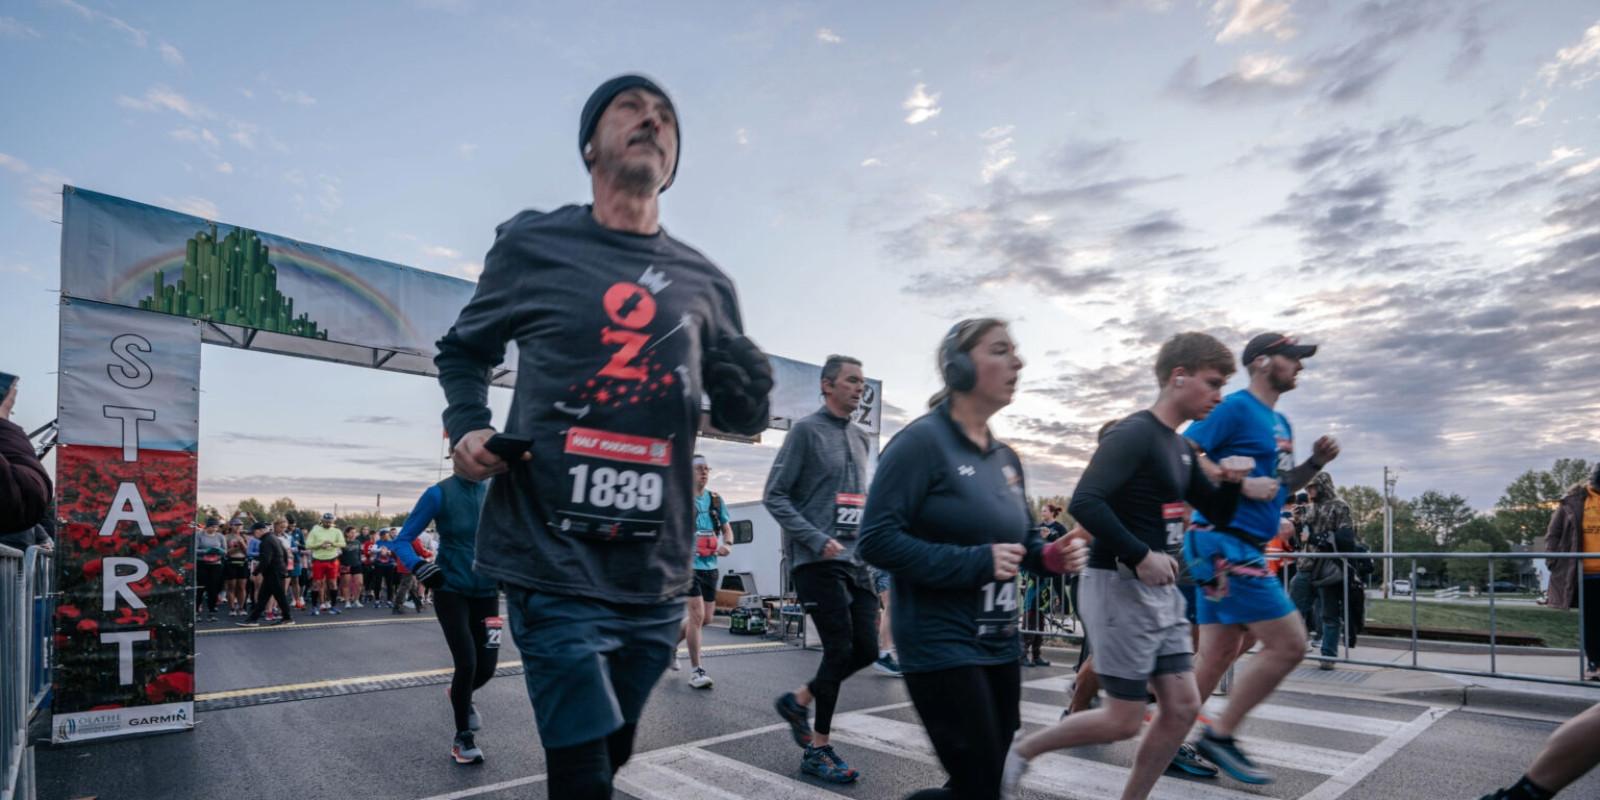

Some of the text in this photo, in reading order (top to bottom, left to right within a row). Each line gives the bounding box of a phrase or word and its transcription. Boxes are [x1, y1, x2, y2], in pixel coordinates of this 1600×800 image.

[98, 333, 156, 686] START
[568, 463, 663, 512] 1839
[128, 711, 187, 727] GARMIN
